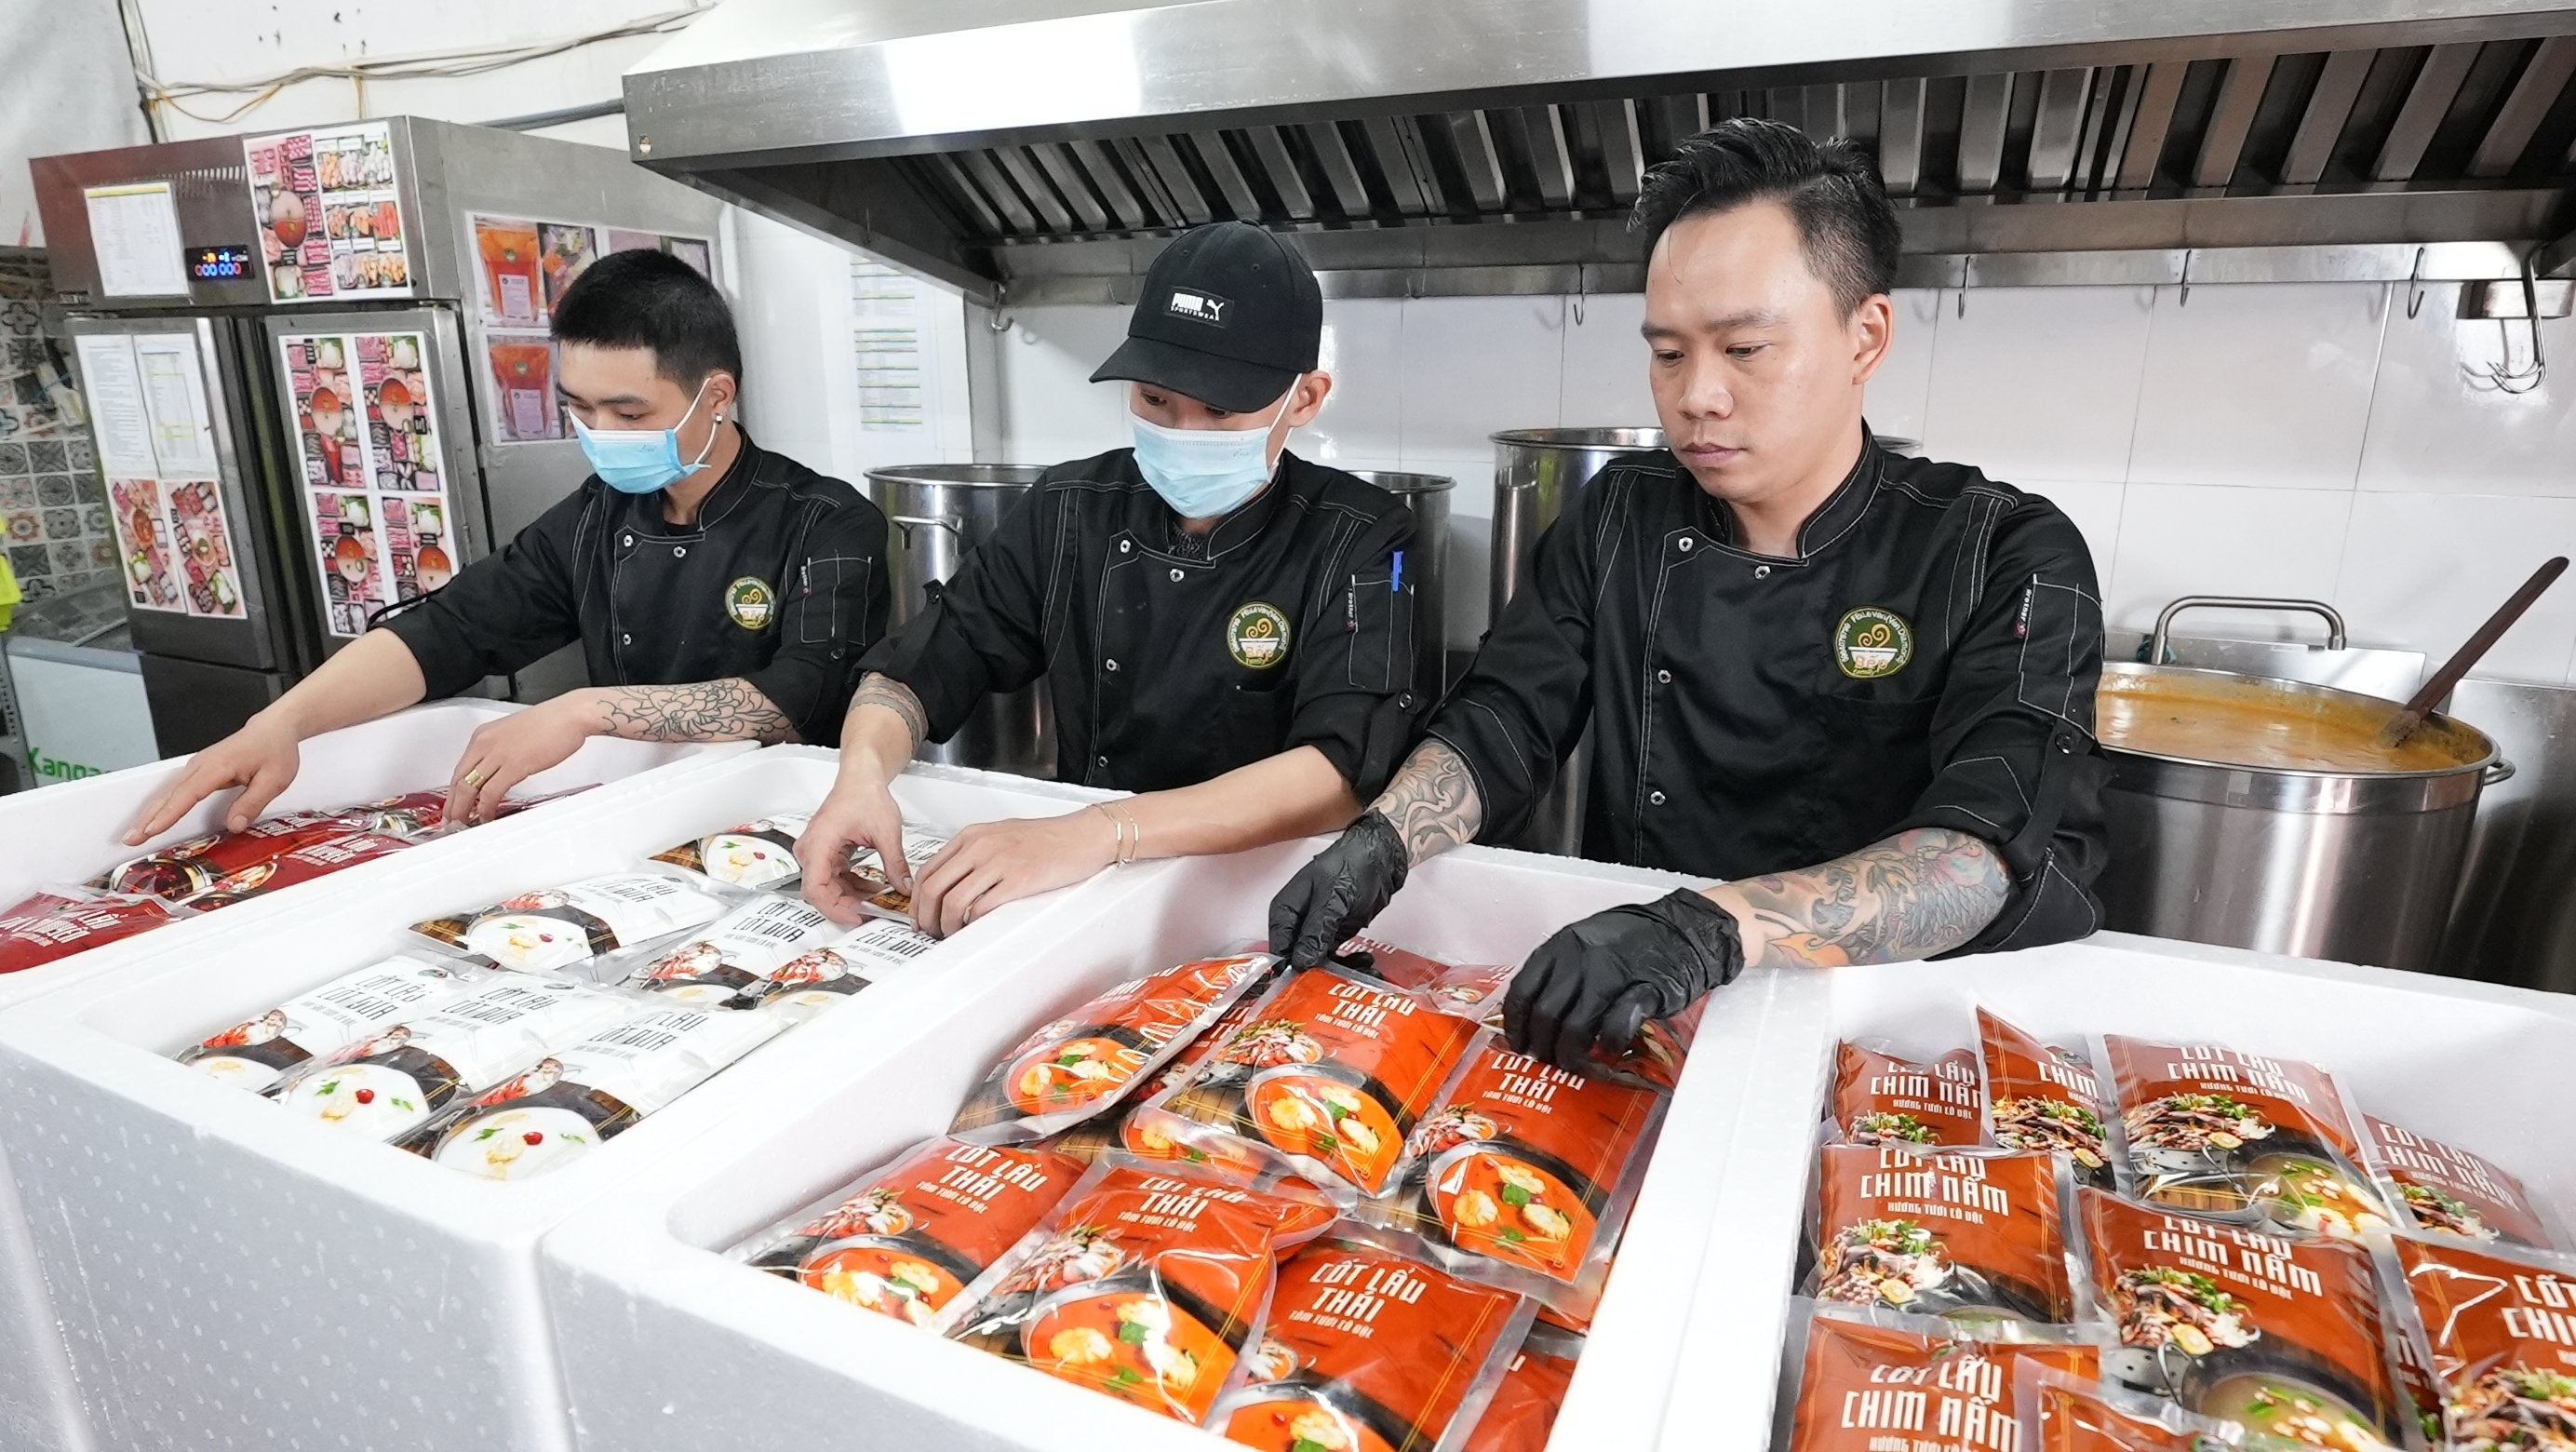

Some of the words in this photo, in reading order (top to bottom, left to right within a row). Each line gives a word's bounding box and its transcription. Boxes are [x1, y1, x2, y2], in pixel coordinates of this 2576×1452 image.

[1331, 999, 1388, 1028] THÁI
[1498, 1072, 1557, 1103] THÁI
[1870, 1075, 1929, 1098] CHIM
[2037, 1061, 2100, 1100] CHIM
[2167, 1062, 2239, 1082] CHIM
[939, 1164, 1006, 1201] THÁI
[1861, 1171, 1933, 1199] CHIM
[1942, 1175, 2009, 1217] NẤM
[1308, 1258, 1370, 1286] CỐT
[1365, 1267, 1427, 1304] LẨU
[2143, 1230, 2229, 1266] CHIM
[2241, 1248, 2323, 1297] NẤM
[1311, 1286, 1386, 1323] THÁI
[1841, 1390, 1927, 1432] CHIM
